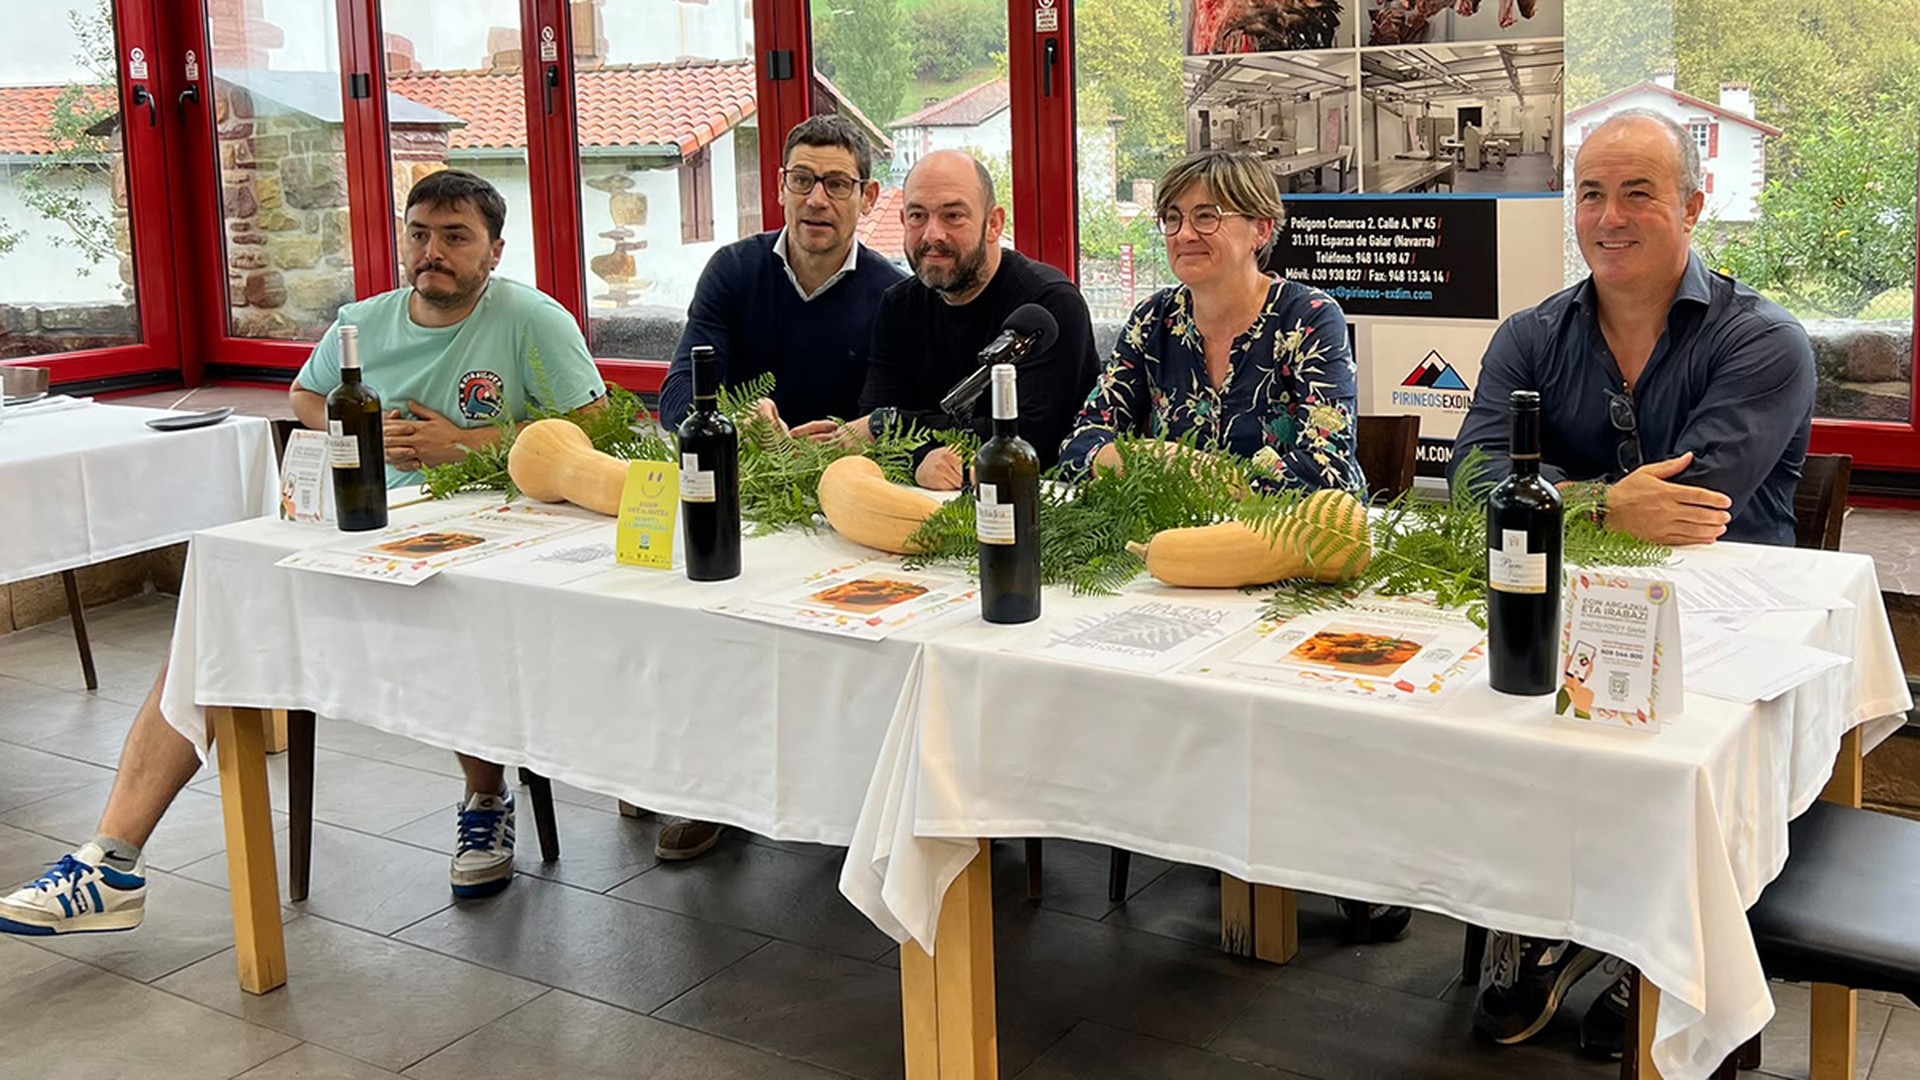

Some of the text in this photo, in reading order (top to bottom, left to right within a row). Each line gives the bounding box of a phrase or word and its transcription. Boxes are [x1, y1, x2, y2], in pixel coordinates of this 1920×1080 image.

[1290, 217, 1326, 231] Polígono
[1328, 218, 1366, 229] Comarca
[1367, 218, 1376, 229] 2.
[1377, 218, 1399, 230] Calle
[1424, 218, 1436, 230] 45
[1291, 234, 1319, 247] 31.191
[1321, 235, 1355, 249] Esparza
[1356, 235, 1367, 247] de
[1368, 235, 1392, 247] Galar
[1394, 235, 1435, 248] (Navarra)
[1316, 252, 1354, 264] Teléfono:
[1355, 252, 1371, 264] 948
[1373, 252, 1384, 264] 14
[1386, 252, 1397, 264] 98
[1398, 252, 1410, 264] 47
[1285, 268, 1310, 280] Móvil:
[1311, 268, 1327, 281] 630
[1328, 269, 1345, 281] 930
[1346, 269, 1362, 281] 827
[1368, 270, 1387, 282] Fax:
[1388, 270, 1404, 282] 948
[1407, 270, 1418, 282] 13
[1419, 271, 1431, 282] 34
[1433, 271, 1444, 283] 14
[1582, 605, 1601, 615] ETA
[1603, 607, 1648, 620] IRABAZI
[1604, 600, 1648, 612] ARGAZKIA
